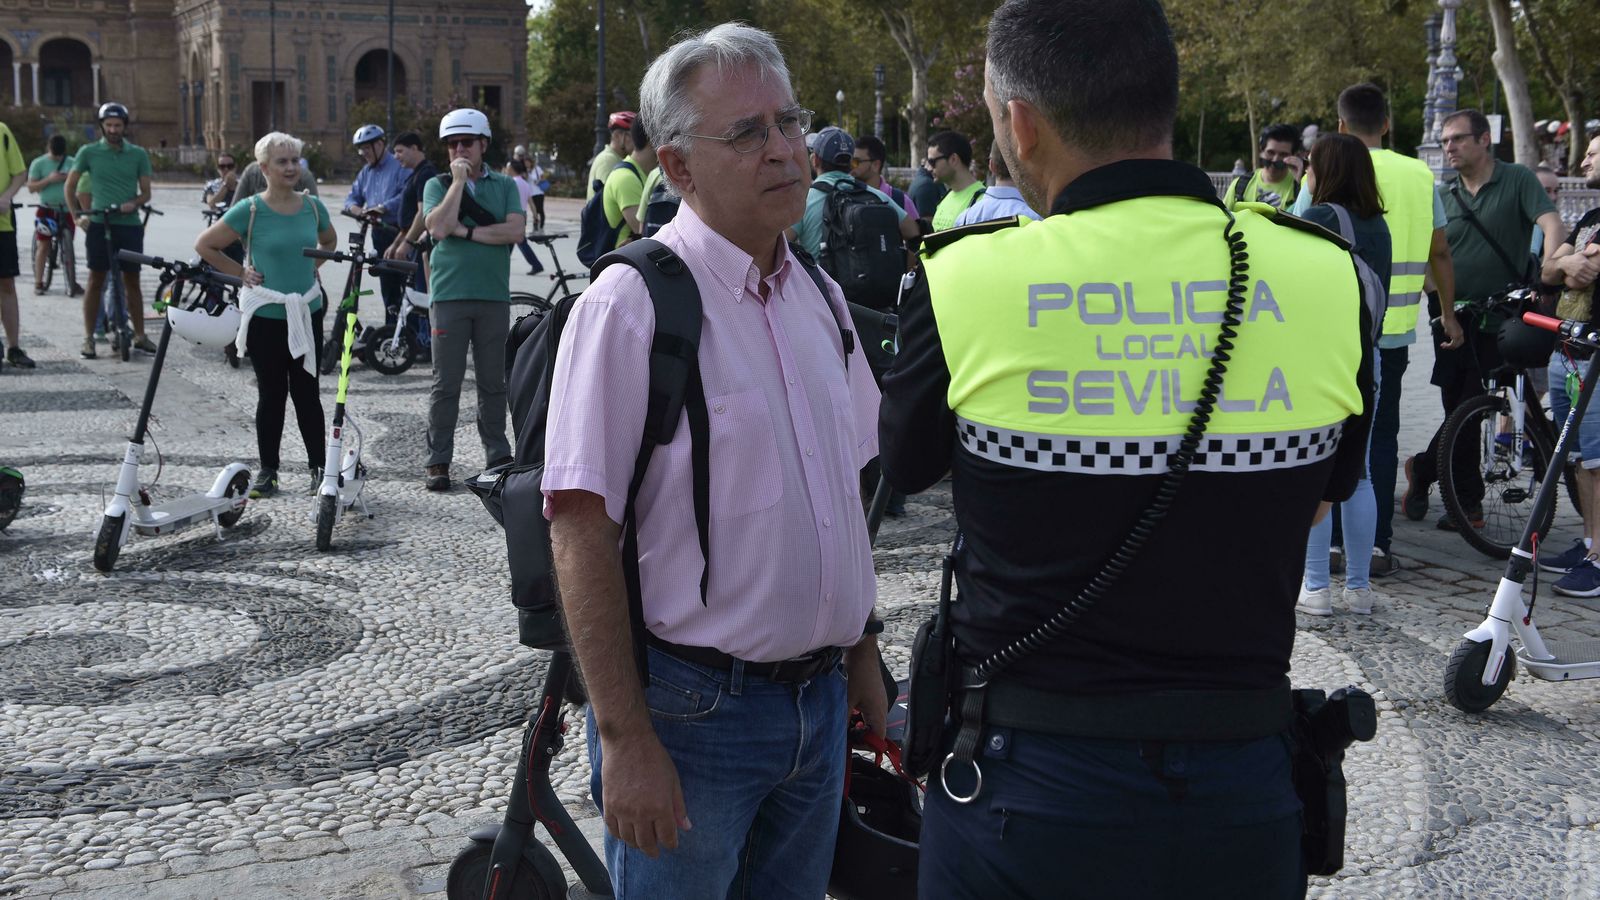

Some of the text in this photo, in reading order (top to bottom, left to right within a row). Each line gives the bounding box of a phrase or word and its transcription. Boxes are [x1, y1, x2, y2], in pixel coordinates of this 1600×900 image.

[1028, 280, 1285, 327] POLICA
[1096, 334, 1220, 360] LOCAL
[1026, 367, 1293, 415] SEVILLA
